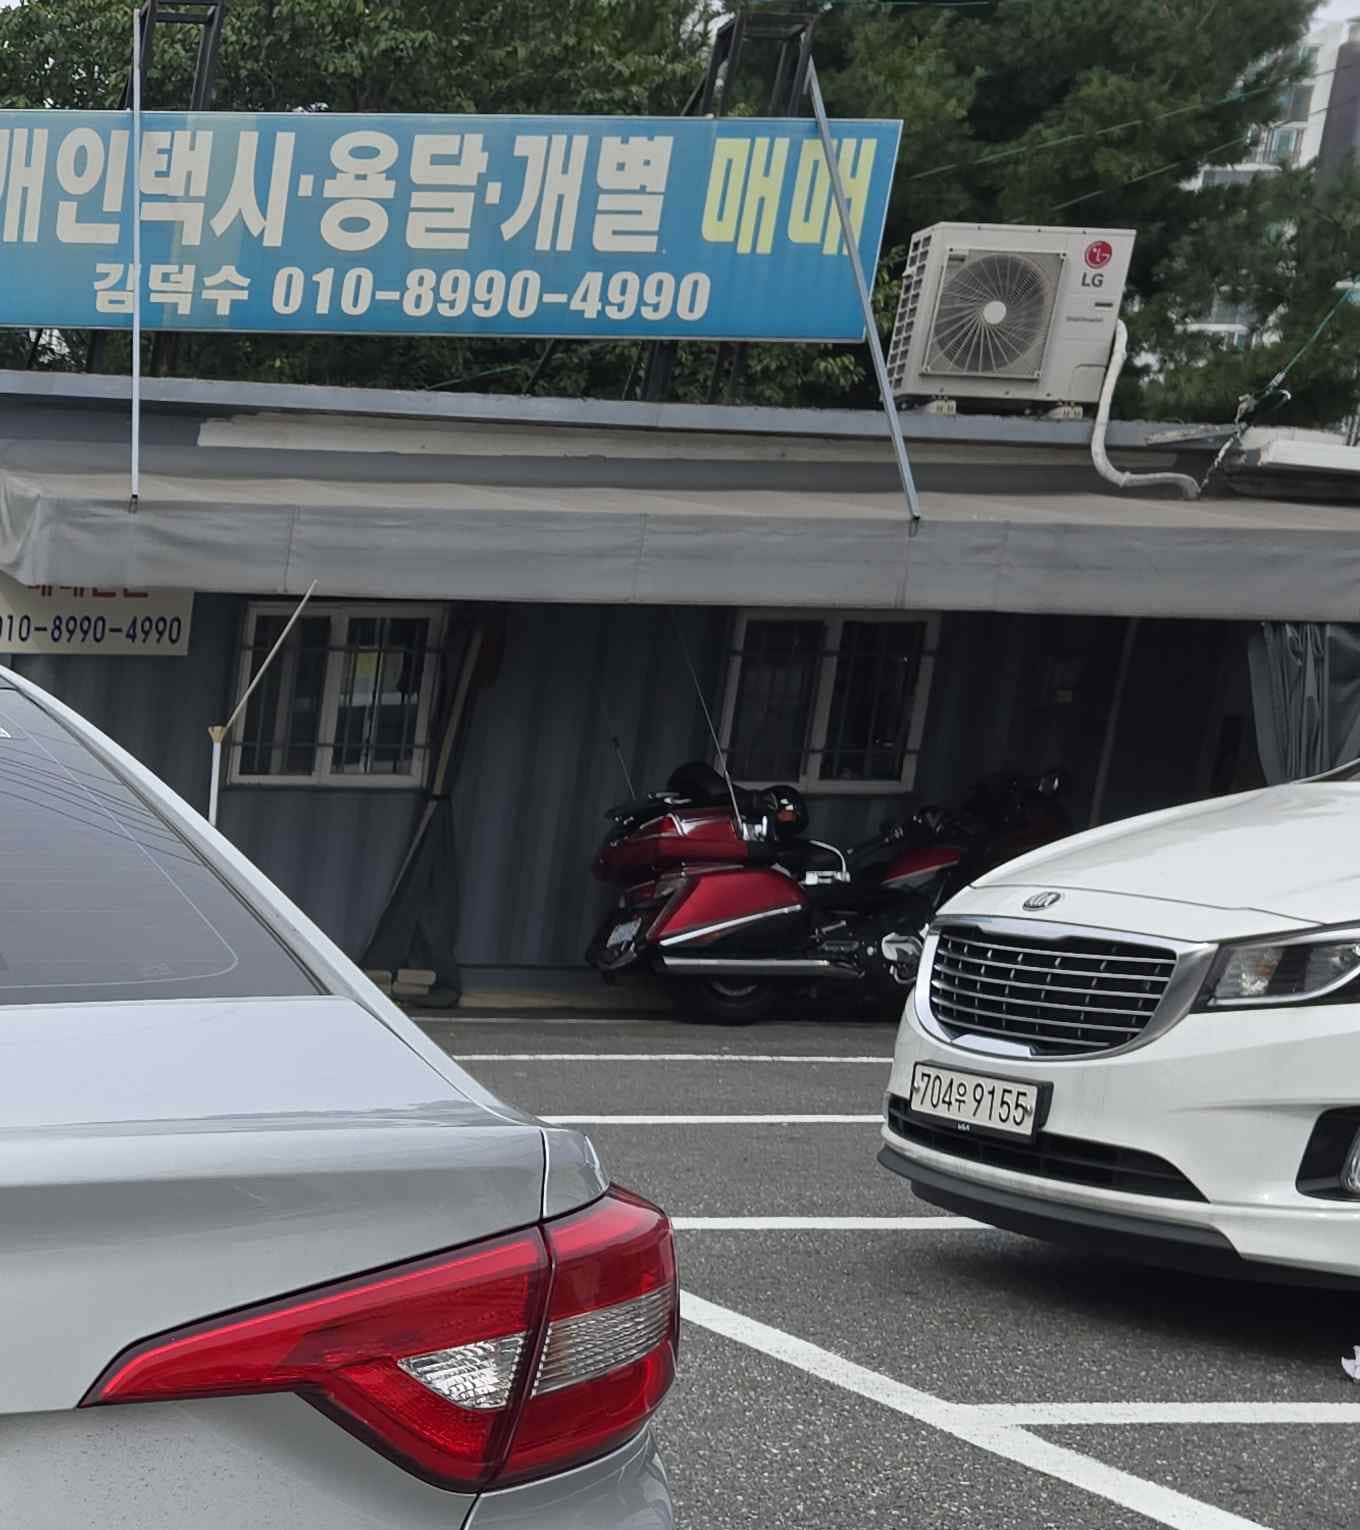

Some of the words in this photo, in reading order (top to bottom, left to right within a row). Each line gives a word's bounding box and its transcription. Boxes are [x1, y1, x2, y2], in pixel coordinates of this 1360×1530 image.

[702, 136, 878, 255] 매매
[93, 263, 251, 316] 김덕수
[272, 265, 711, 321] 010-8990-4990
[1081, 272, 1104, 288] LG
[920, 1071, 967, 1113] 704우
[973, 1083, 1032, 1126] 9155
